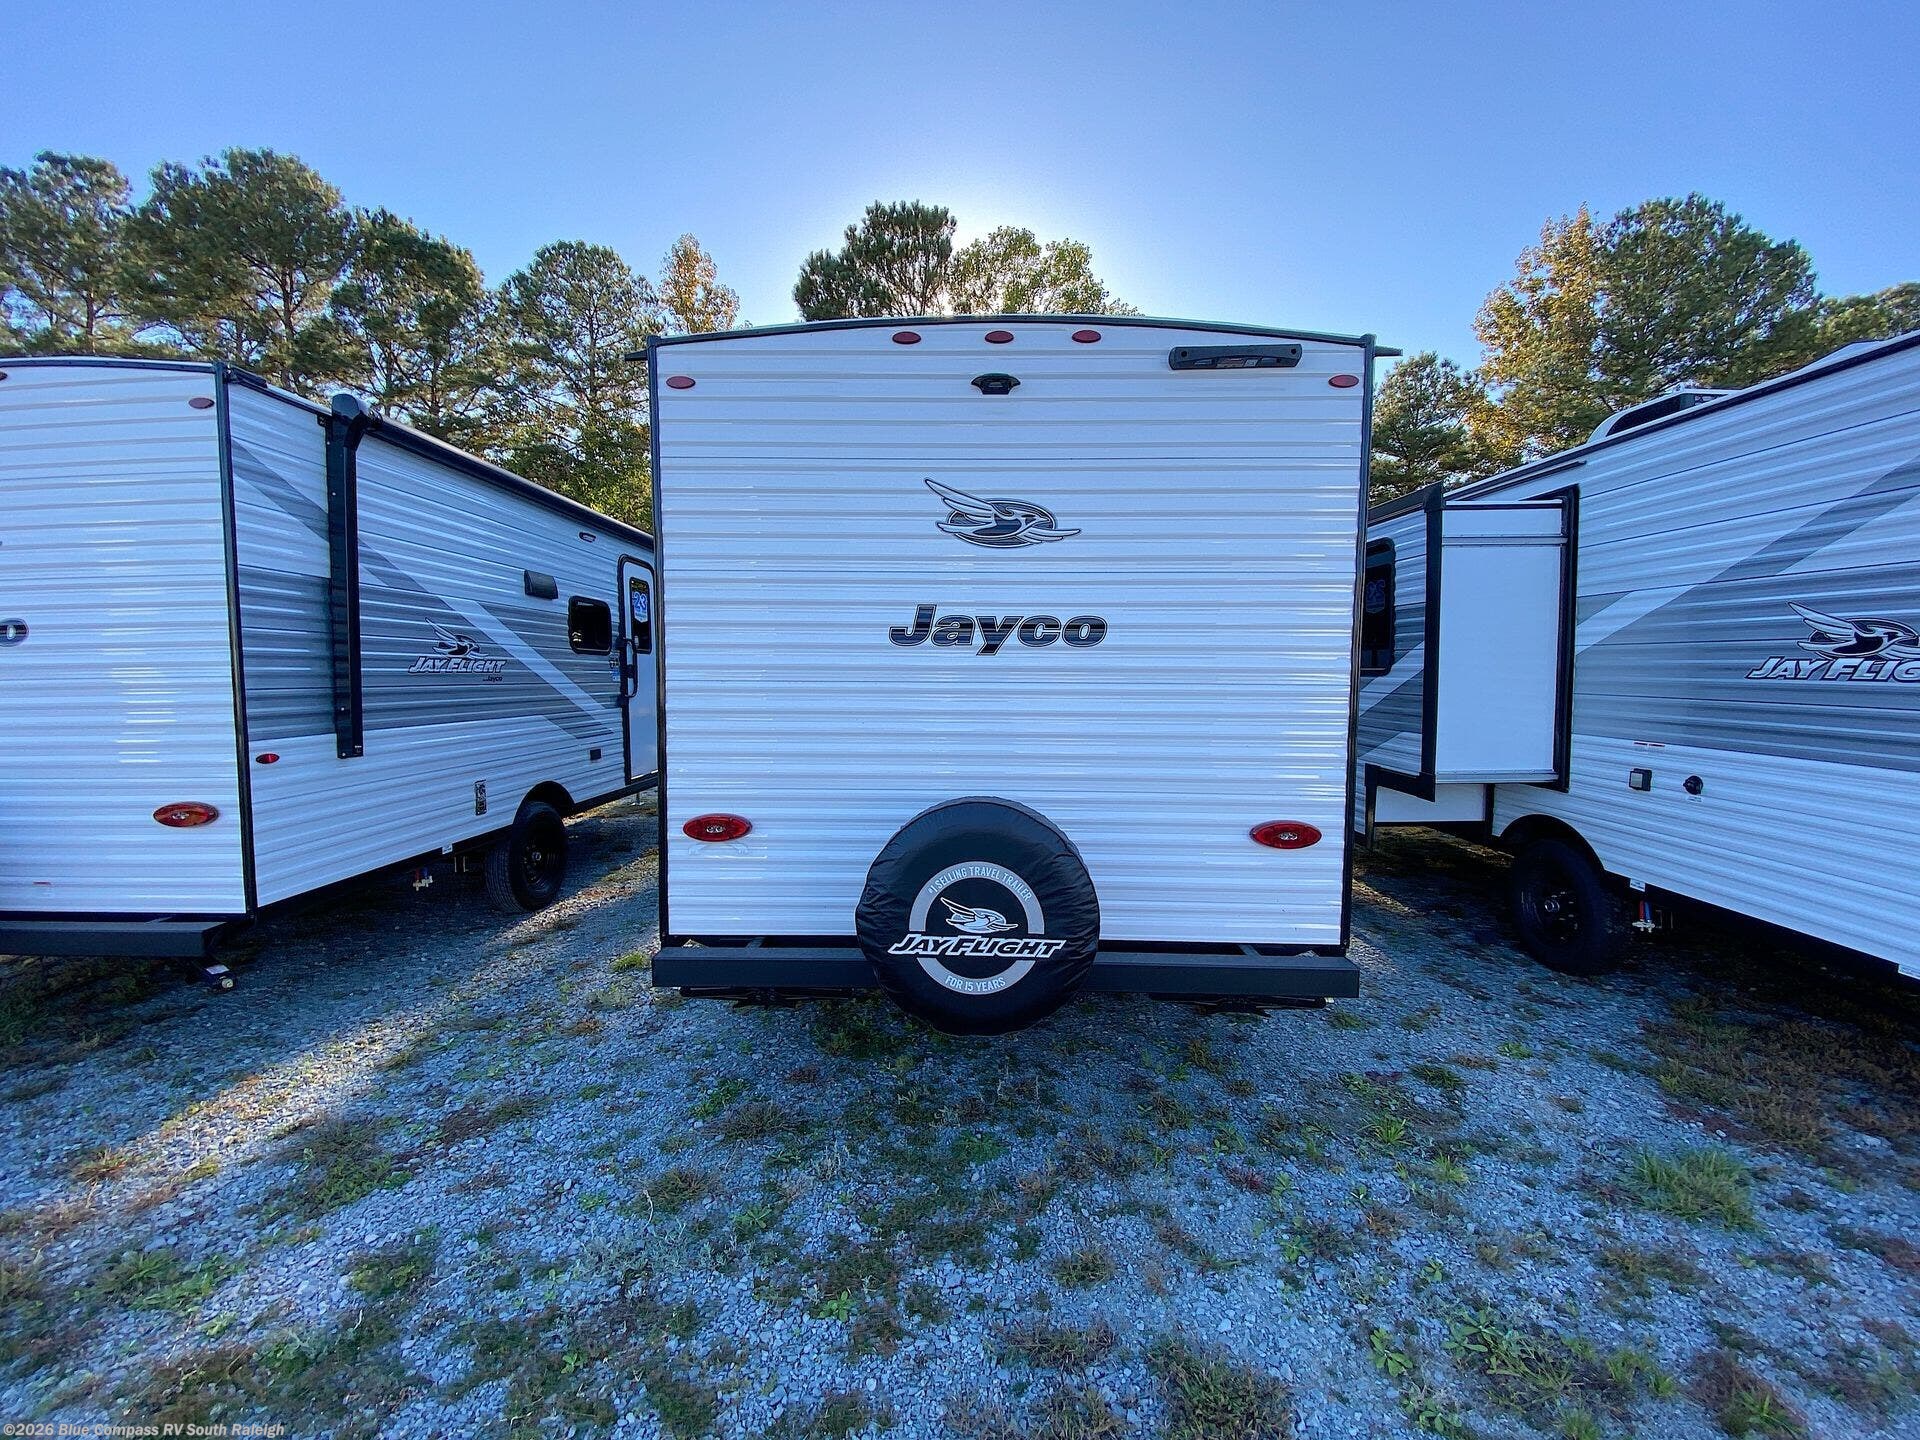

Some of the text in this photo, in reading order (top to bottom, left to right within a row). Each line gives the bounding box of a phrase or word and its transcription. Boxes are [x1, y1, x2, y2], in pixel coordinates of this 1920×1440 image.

[888, 604, 1108, 656] Jayco
[935, 868, 967, 889] SELLING
[969, 866, 1001, 880] TRAVEL
[1002, 872, 1032, 902] TRAILER
[945, 976, 1006, 992] FOR 15 YEARS
